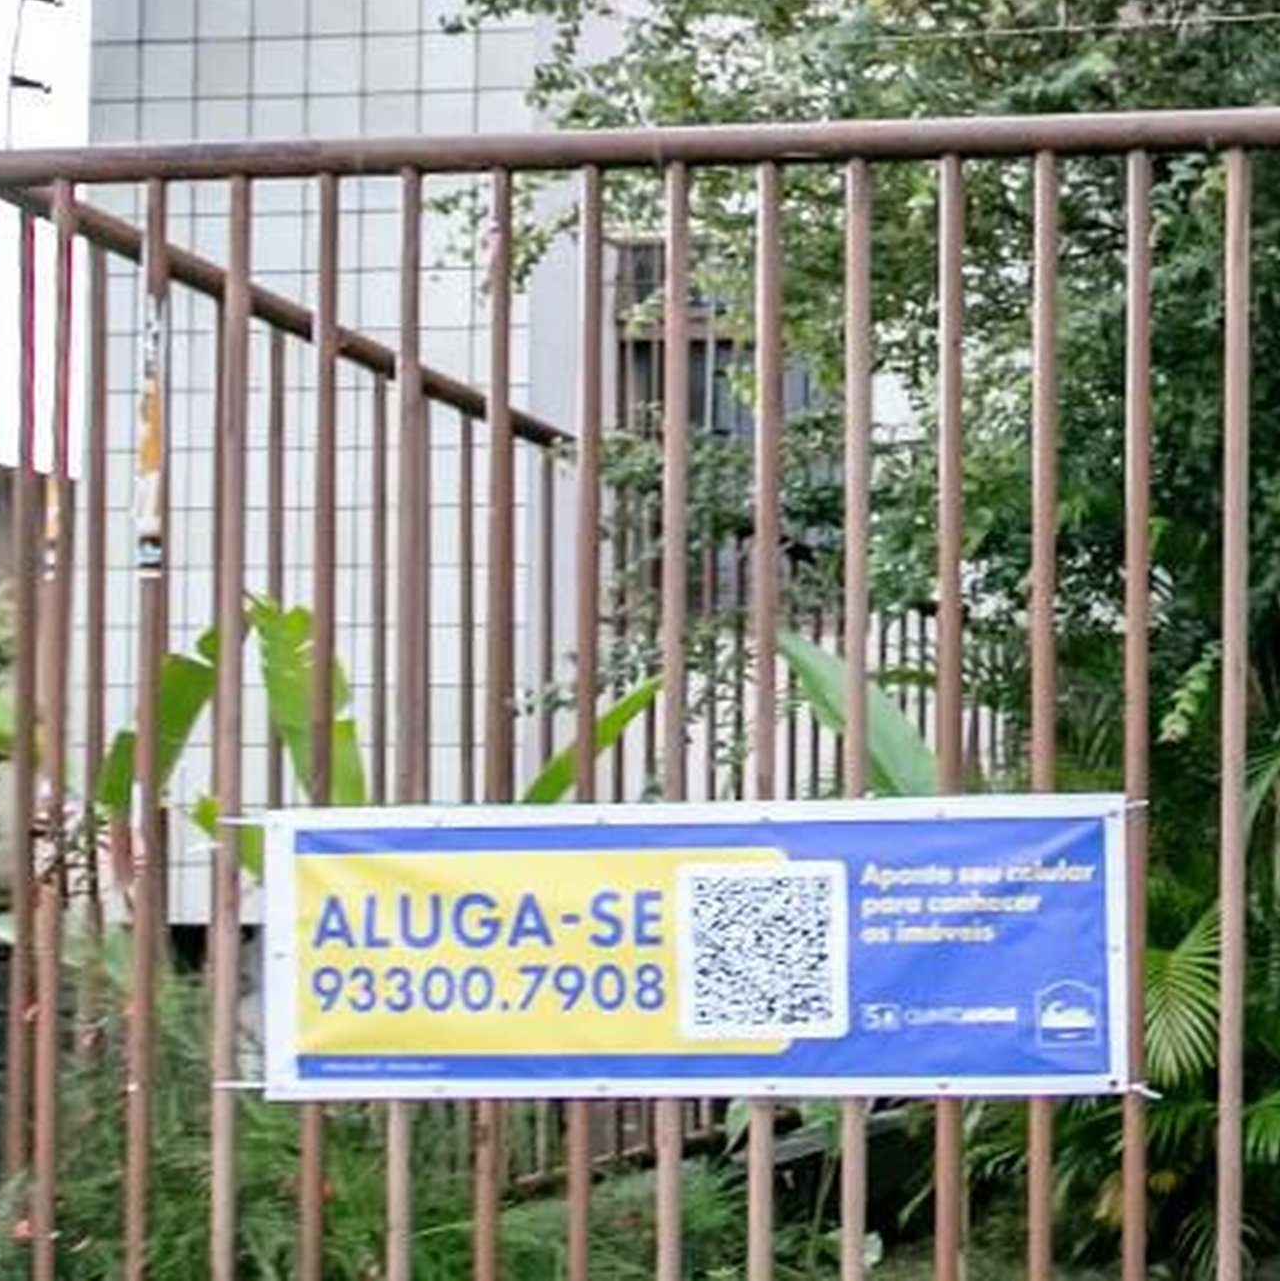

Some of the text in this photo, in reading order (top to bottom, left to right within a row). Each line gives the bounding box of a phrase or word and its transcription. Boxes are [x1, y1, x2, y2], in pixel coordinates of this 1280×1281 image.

[860, 859, 1096, 891] Aponte seu celular
[312, 890, 663, 949] ALUGA-SE
[860, 890, 1041, 919] para conhecer
[860, 926, 890, 943] os
[312, 963, 665, 1012] 93300.7908
